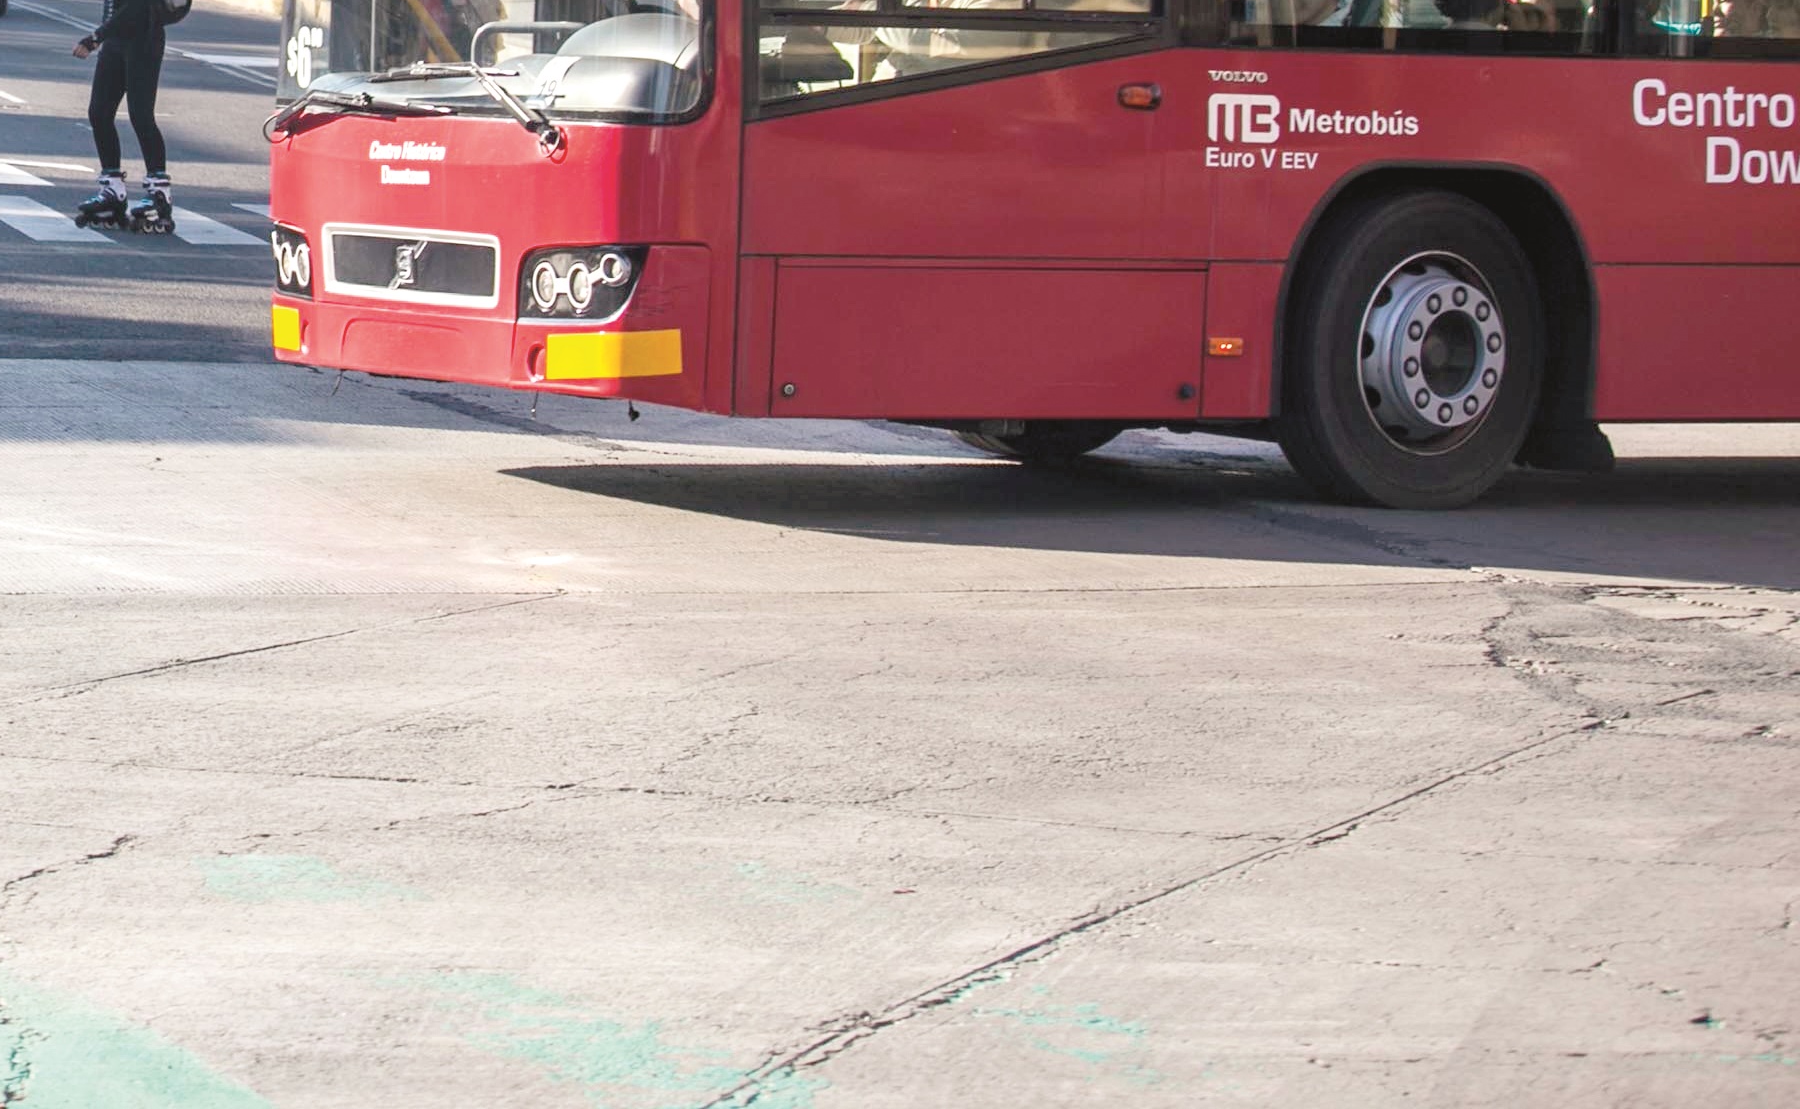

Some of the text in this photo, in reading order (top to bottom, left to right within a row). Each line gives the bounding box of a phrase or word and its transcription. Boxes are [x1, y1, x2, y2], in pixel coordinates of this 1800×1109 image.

[1208, 70, 1269, 83] VOLVO
[1633, 78, 1795, 128] Centro
[1289, 108, 1419, 136] Metrobús
[1205, 147, 1318, 169] Euro V EEV
